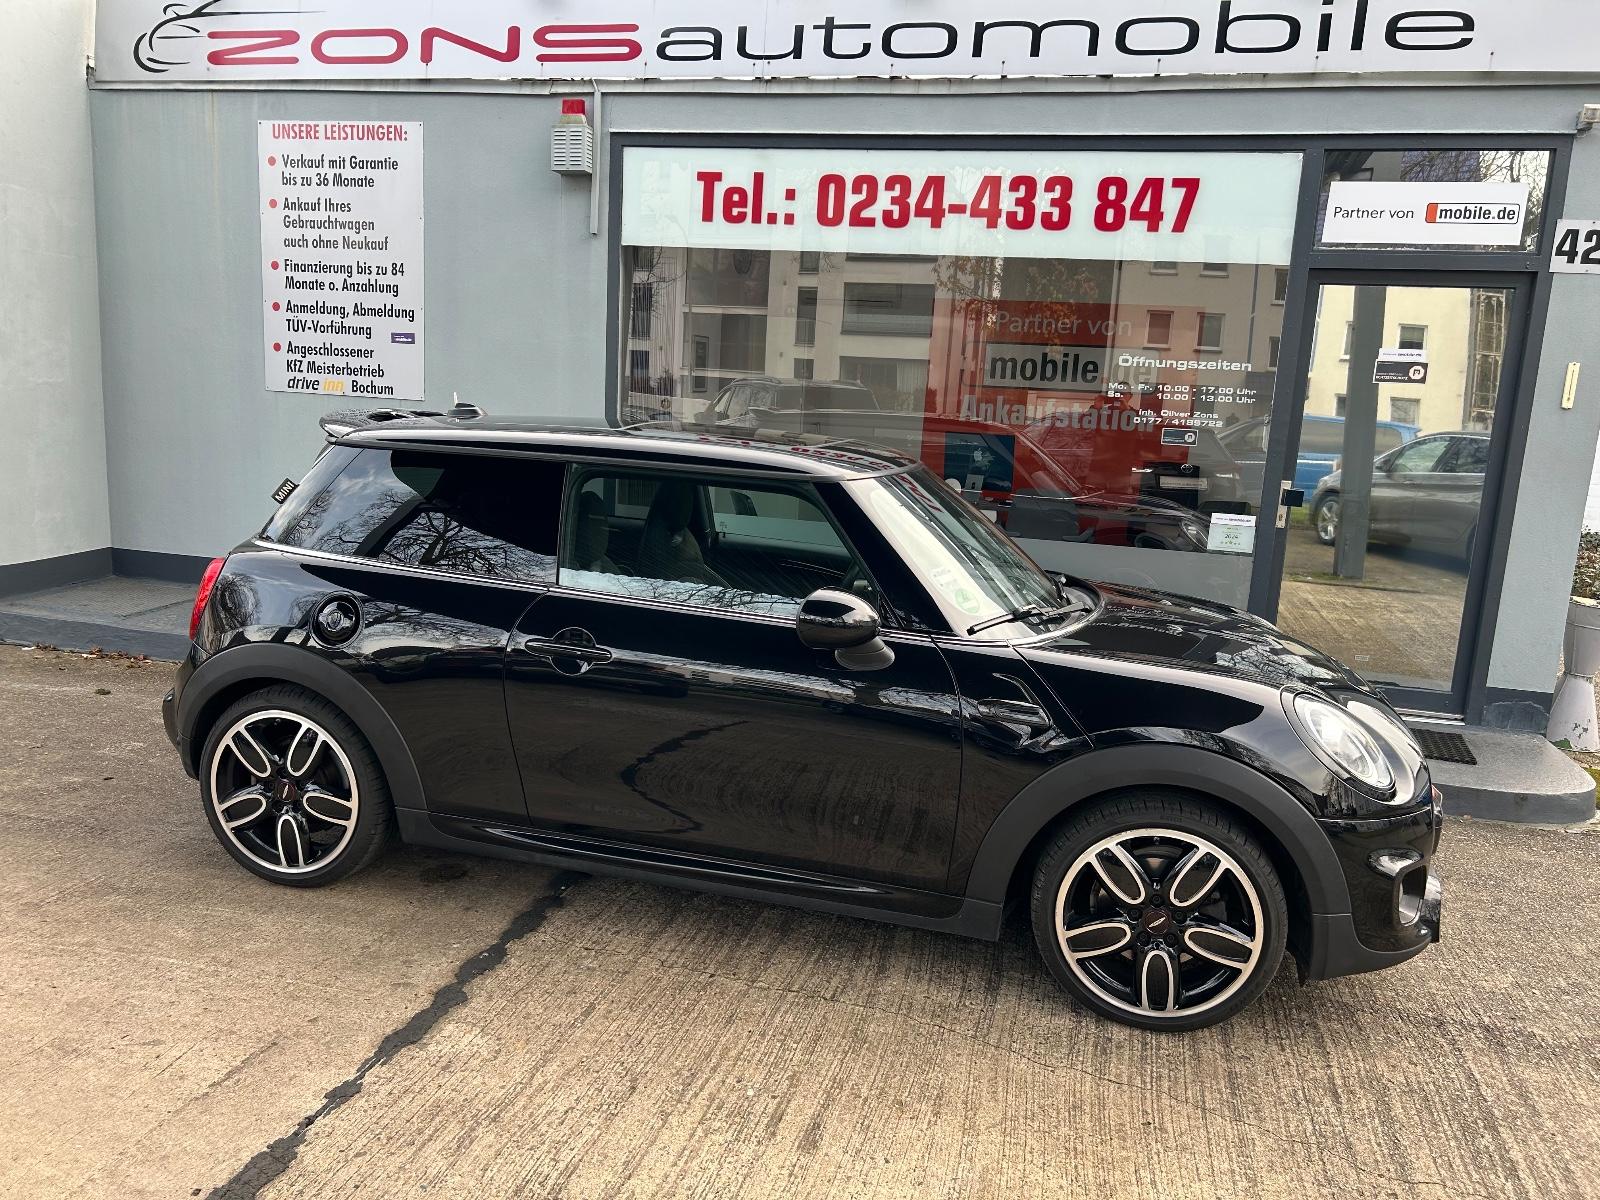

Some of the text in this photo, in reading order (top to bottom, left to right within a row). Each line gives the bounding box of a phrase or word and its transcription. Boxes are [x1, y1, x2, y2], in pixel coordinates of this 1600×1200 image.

[272, 123, 408, 142] UNSERE LEISTUNGEN:
[282, 154, 399, 170] Verkauf mit Garantie
[281, 171, 375, 188] bis zu 36 Monate
[282, 197, 352, 212] Ankauf Ihres
[697, 171, 1201, 234] Tel.: 0234-433 847
[1333, 205, 1516, 221] Partner von mobile.de
[283, 214, 375, 234] Gebrauchtwagen
[283, 234, 389, 251] auch ohne Neukauf
[1554, 228, 1600, 265] 42
[284, 259, 405, 278] Finanzierung bis zu 84
[285, 276, 399, 297] Monate o. Anzahlung
[285, 300, 415, 322] Anmeldung, Abmeldung
[286, 315, 372, 339] TÜV-Vorführung
[996, 311, 1132, 337] Partner von
[286, 341, 374, 358] Angeschlossener
[286, 359, 385, 378] KfZ Meisterbetrieb
[1118, 353, 1252, 371] Öffnungszeiten
[287, 376, 320, 391] drive
[351, 380, 394, 395] Bochum
[1108, 382, 1127, 390] Mo.
[1138, 383, 1153, 391] Fr.
[1157, 384, 1190, 392] 10.00
[1200, 386, 1234, 395] 17.00
[1236, 387, 1257, 396] Uhr
[1107, 390, 1124, 398] Sa.
[1156, 393, 1189, 401] 10.00
[1200, 395, 1233, 403] 13.00
[1236, 396, 1256, 404] Uhr
[959, 394, 1155, 432] Ankaufstation
[1133, 417, 1162, 425] 0177
[1138, 408, 1219, 419] Inh. Oliver Zons
[274, 481, 295, 502] MINI
